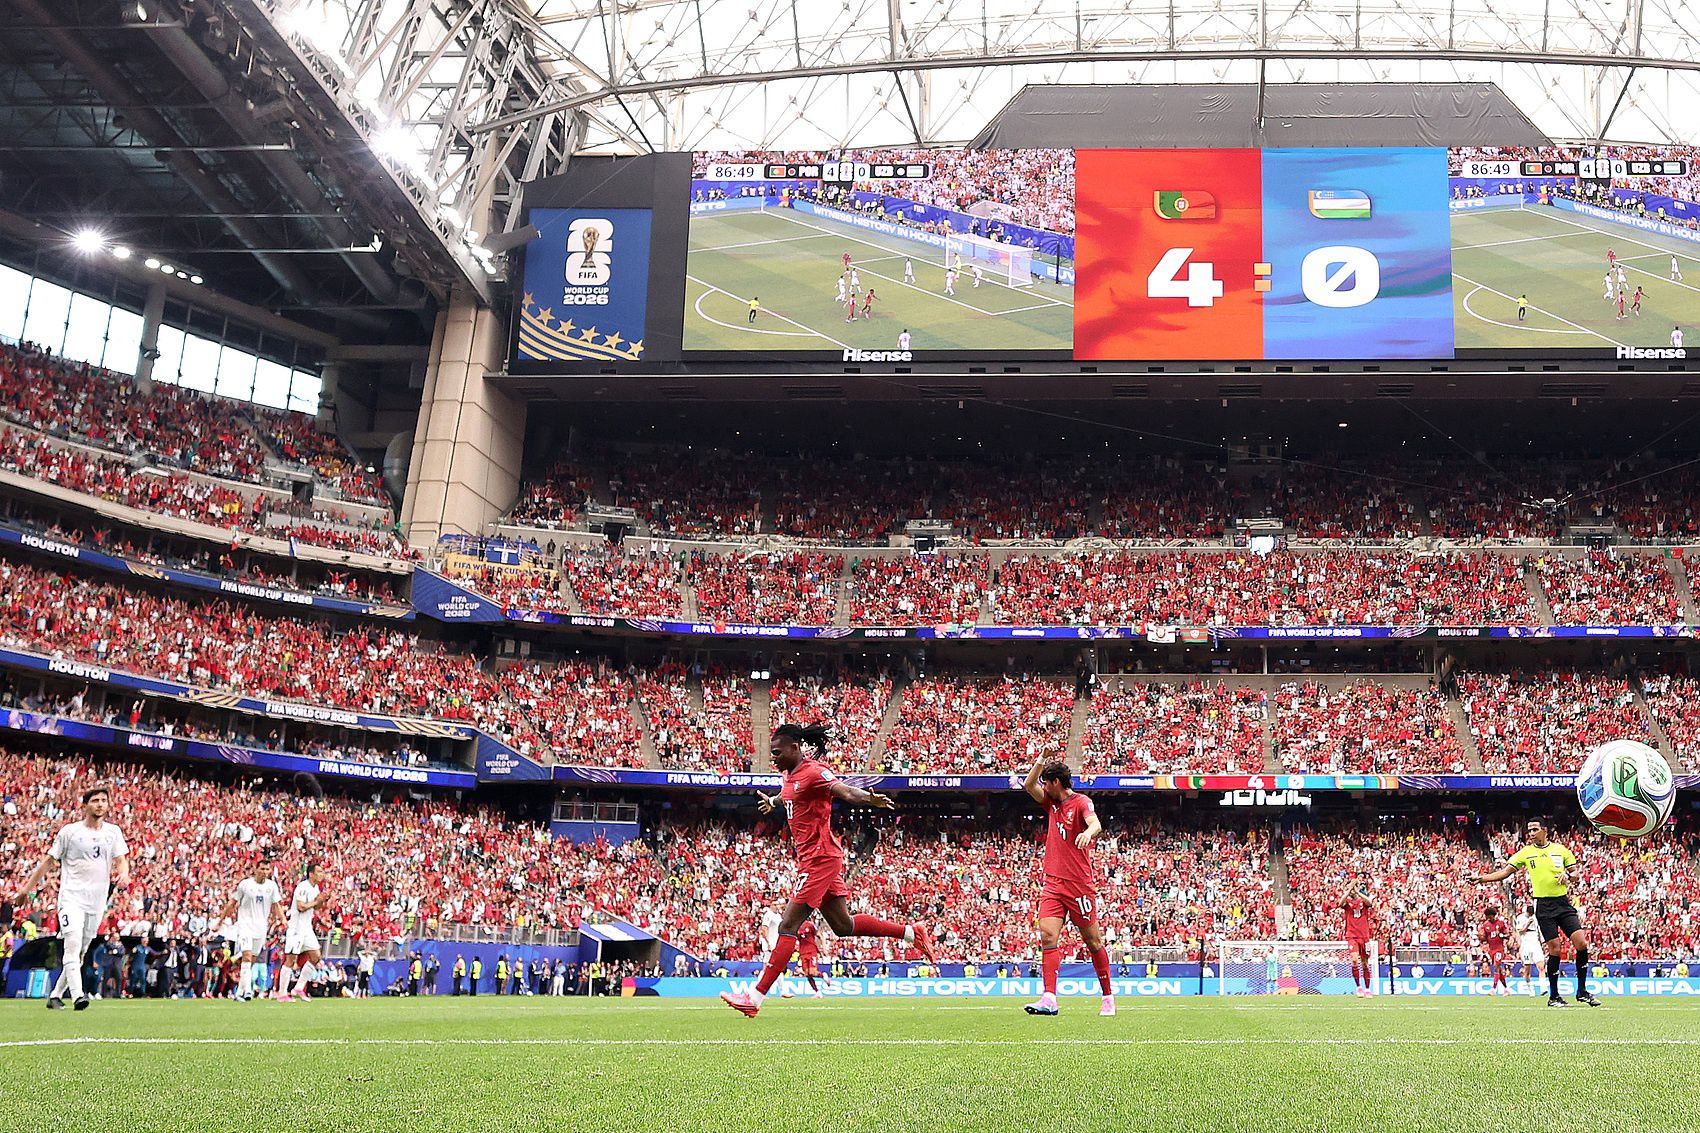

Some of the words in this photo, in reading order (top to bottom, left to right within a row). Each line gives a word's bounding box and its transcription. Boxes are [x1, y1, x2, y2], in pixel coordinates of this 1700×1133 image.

[715, 166, 755, 178] 86:49
[827, 167, 834, 177] 4
[1471, 164, 1510, 174] 86:49
[1584, 164, 1590, 173] 4
[1573, 203, 1614, 220] WITNESS
[1614, 214, 1658, 231] HISTORY
[1660, 223, 1672, 233] IN
[814, 206, 852, 222] WITNESS
[854, 216, 899, 234] HISTORY
[898, 226, 908, 236] IN
[908, 230, 962, 250] HOUSTON
[1147, 247, 1224, 307] 4
[1301, 245, 1381, 308] 0
[564, 286, 592, 294] WORLD
[593, 286, 610, 294] CUP
[562, 294, 609, 305] 2026
[843, 348, 912, 362] Hisense
[1616, 346, 1686, 360] Hisense
[21, 534, 80, 558] HOUSTON
[220, 580, 238, 592] FIFA
[238, 584, 265, 598] WORLD
[266, 590, 282, 600] CUP
[571, 616, 615, 627] HOUSTON
[692, 624, 710, 632] FIFA
[742, 626, 758, 634] CUP
[864, 629, 906, 637] HOUSTON
[1268, 628, 1286, 636] FIFA
[1286, 628, 1316, 636] WORLD
[1316, 628, 1332, 636] CUP
[1438, 628, 1480, 636] HOUSTON
[48, 660, 110, 682] HOUSTON
[266, 703, 284, 714] FIFA
[286, 705, 314, 718] WORLD
[314, 710, 330, 720] CUP
[128, 733, 174, 751] HOUSTON
[320, 761, 339, 774] FIFA
[340, 763, 372, 777] WORLD
[372, 768, 392, 778] CUP
[392, 770, 428, 782] 2026
[668, 774, 690, 784] FIFA
[691, 774, 730, 784] WORLD
[730, 776, 752, 785] CUP
[908, 778, 961, 787] HOUSTON
[1247, 776, 1264, 790] 4
[1288, 776, 1305, 790] 0
[1490, 777, 1514, 786] FIFA
[1514, 777, 1552, 786] WORLD
[1552, 777, 1574, 786] CUP
[93, 846, 100, 858] 3
[1076, 894, 1092, 915] 16
[62, 914, 70, 928] 3
[867, 980, 996, 995] HISTORY
[1001, 980, 1031, 995] IN
[1383, 980, 1441, 994] BUY
[1583, 980, 1624, 994] ON
